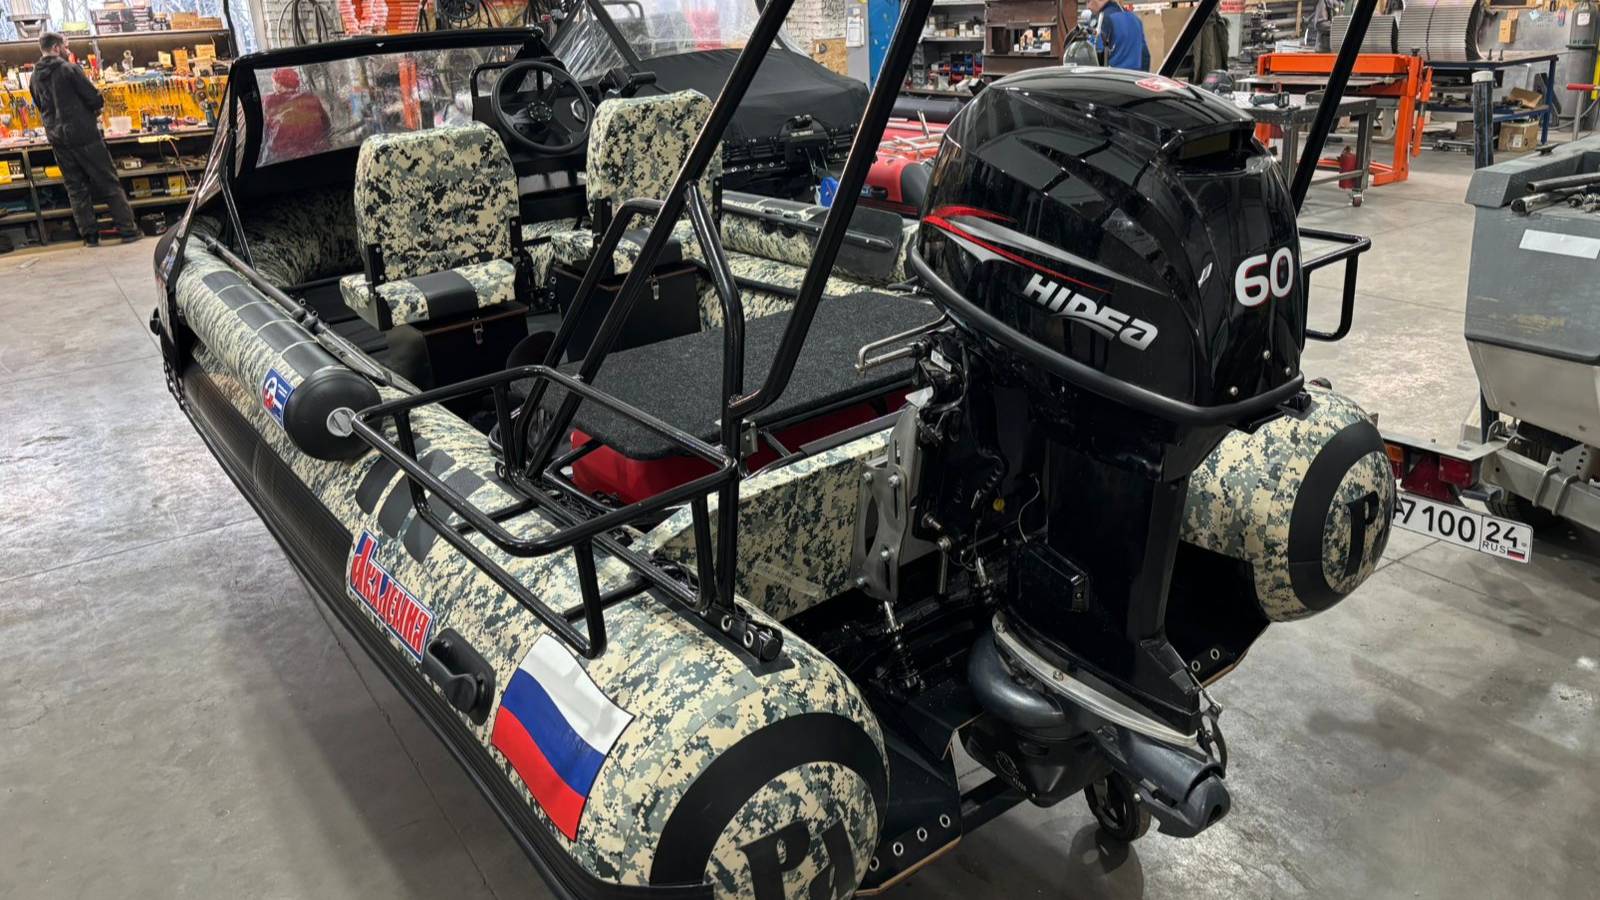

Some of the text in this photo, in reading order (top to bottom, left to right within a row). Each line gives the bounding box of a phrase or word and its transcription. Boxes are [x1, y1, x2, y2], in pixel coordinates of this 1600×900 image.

[1235, 247, 1294, 307] 60
[1022, 273, 1159, 351] HIDEA
[1482, 540, 1507, 554] RUS
[1485, 521, 1518, 548] 24
